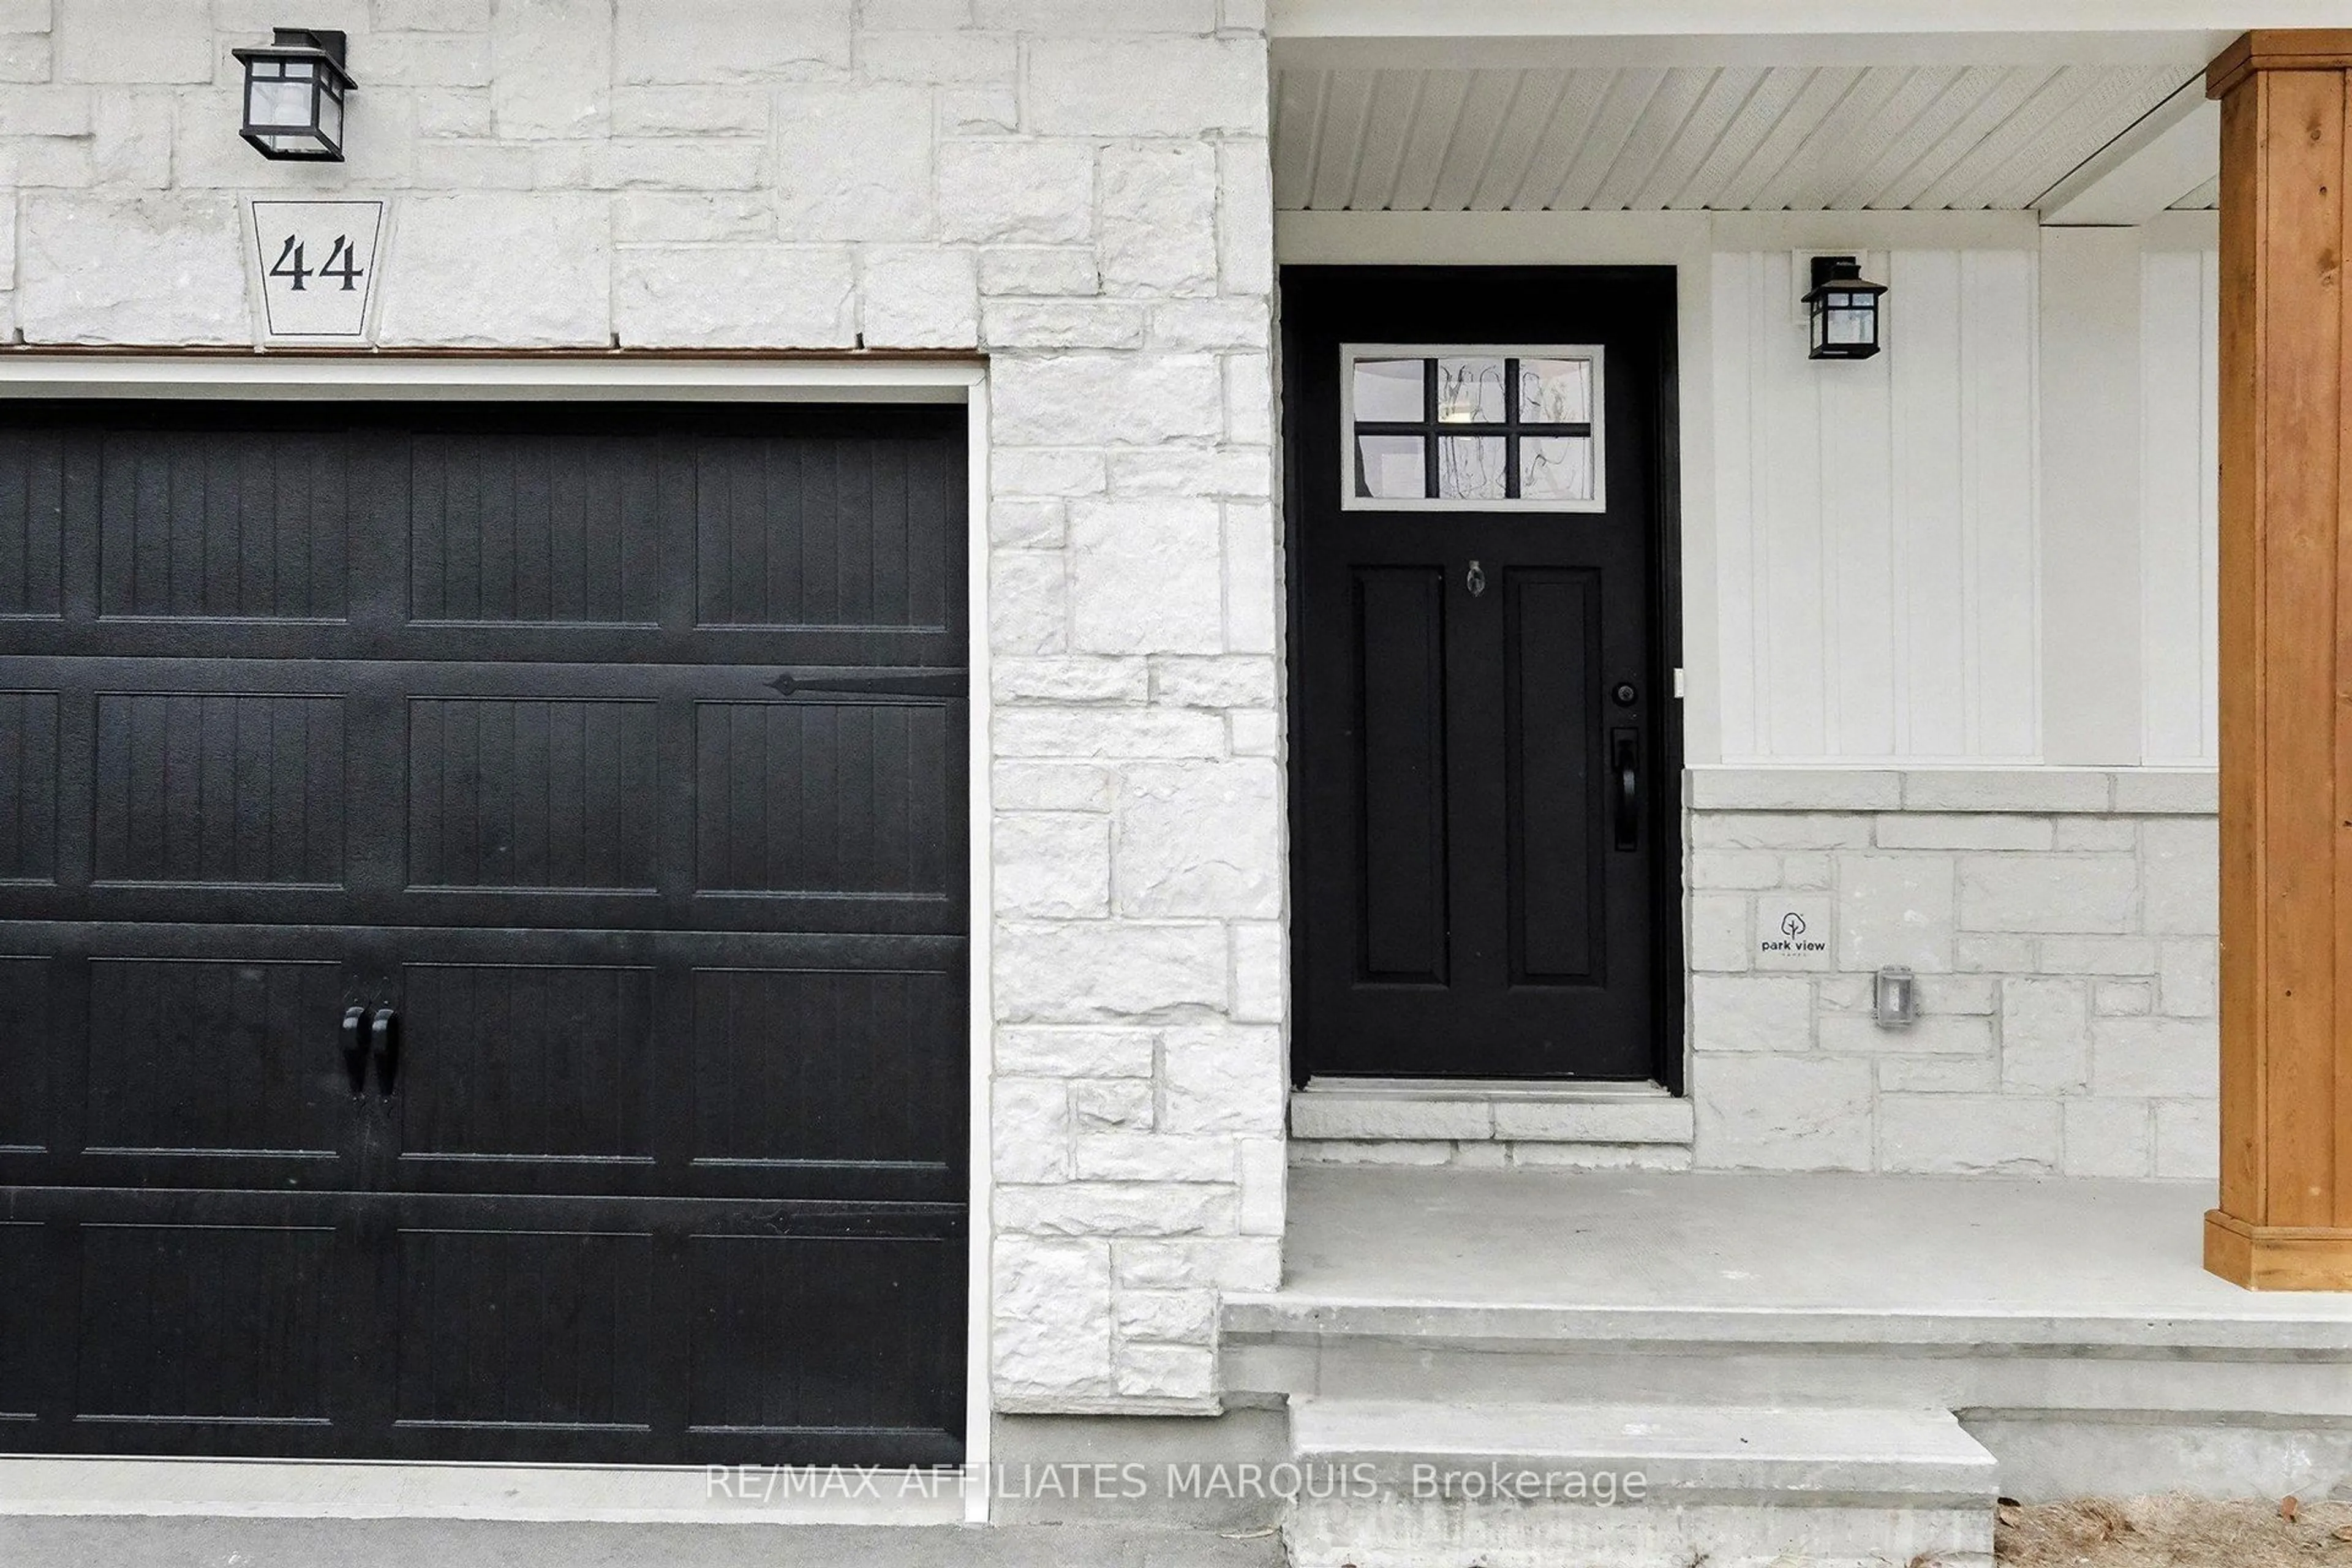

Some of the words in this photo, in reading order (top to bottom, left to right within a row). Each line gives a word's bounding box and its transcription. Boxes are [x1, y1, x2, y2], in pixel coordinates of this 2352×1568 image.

[269, 233, 364, 291] 44
[1762, 940, 1791, 951] park
[1795, 940, 1825, 950] view
